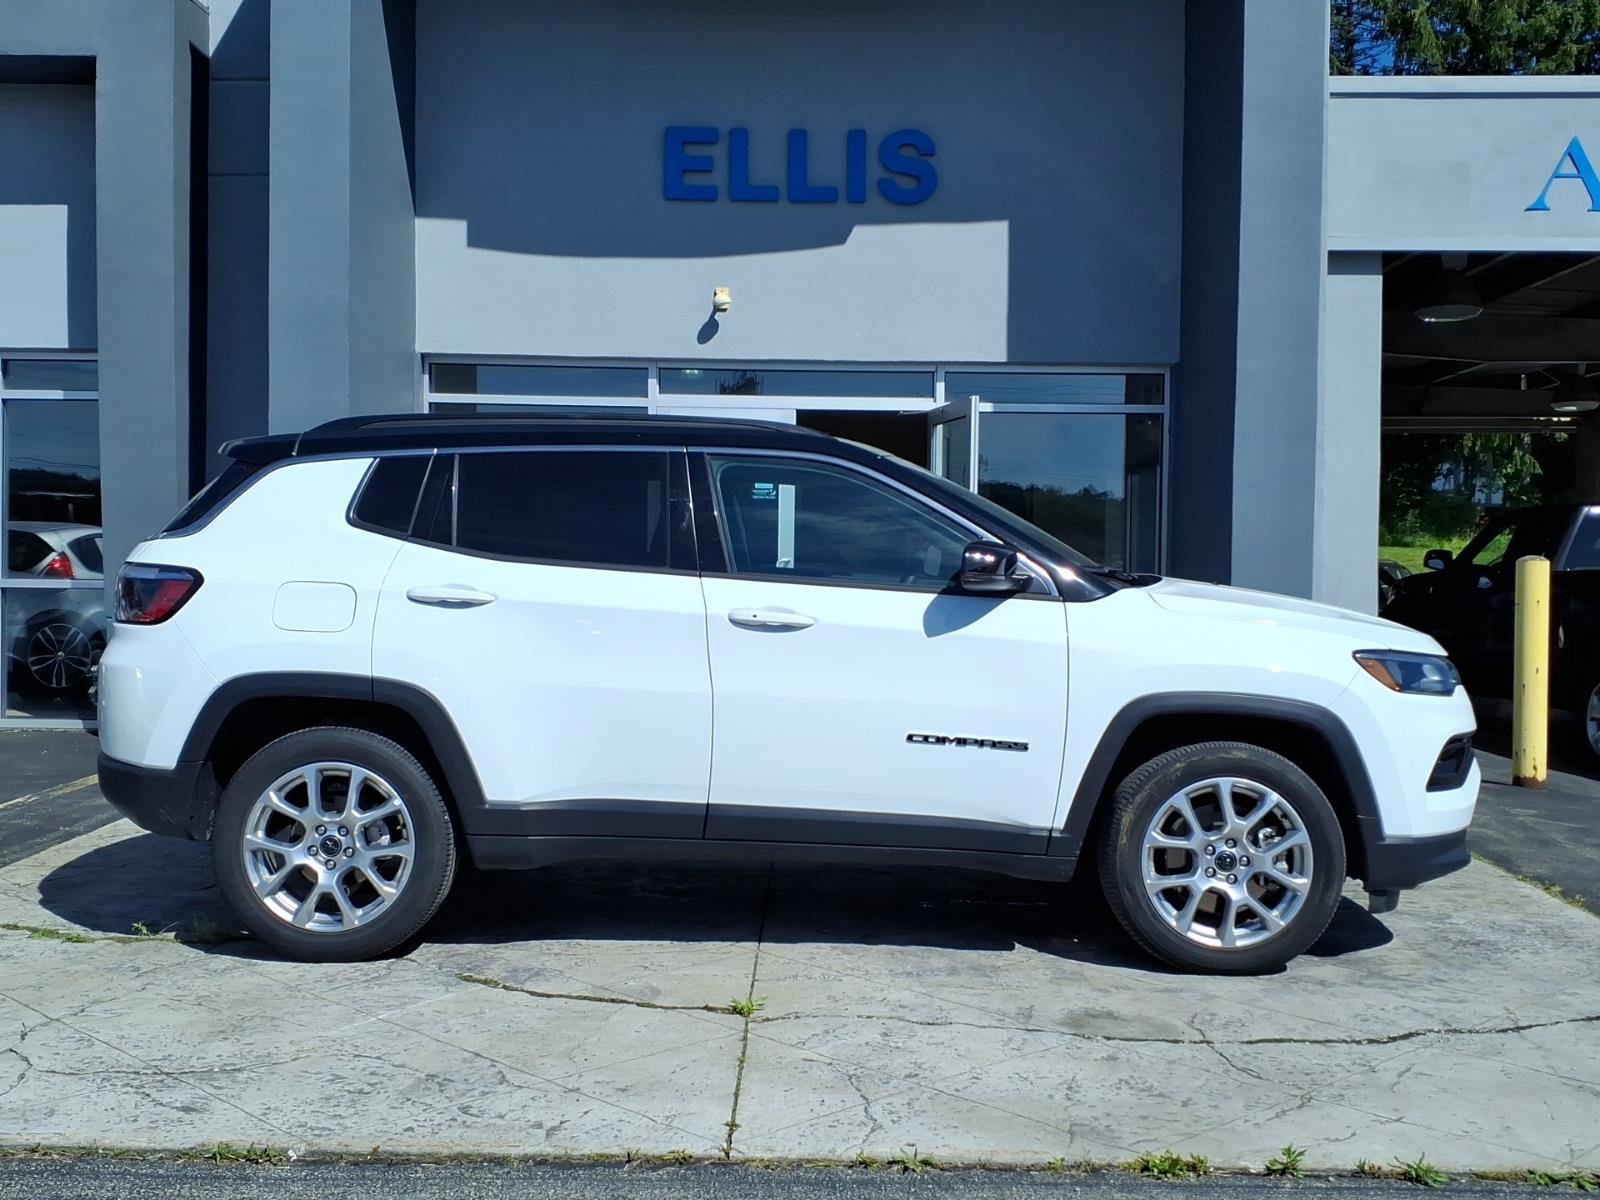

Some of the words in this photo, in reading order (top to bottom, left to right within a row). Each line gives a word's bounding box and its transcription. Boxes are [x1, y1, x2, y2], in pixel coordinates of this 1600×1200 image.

[663, 126, 938, 206] ELLIS
[1524, 134, 1600, 212] A
[906, 733, 1029, 752] COMPASS
